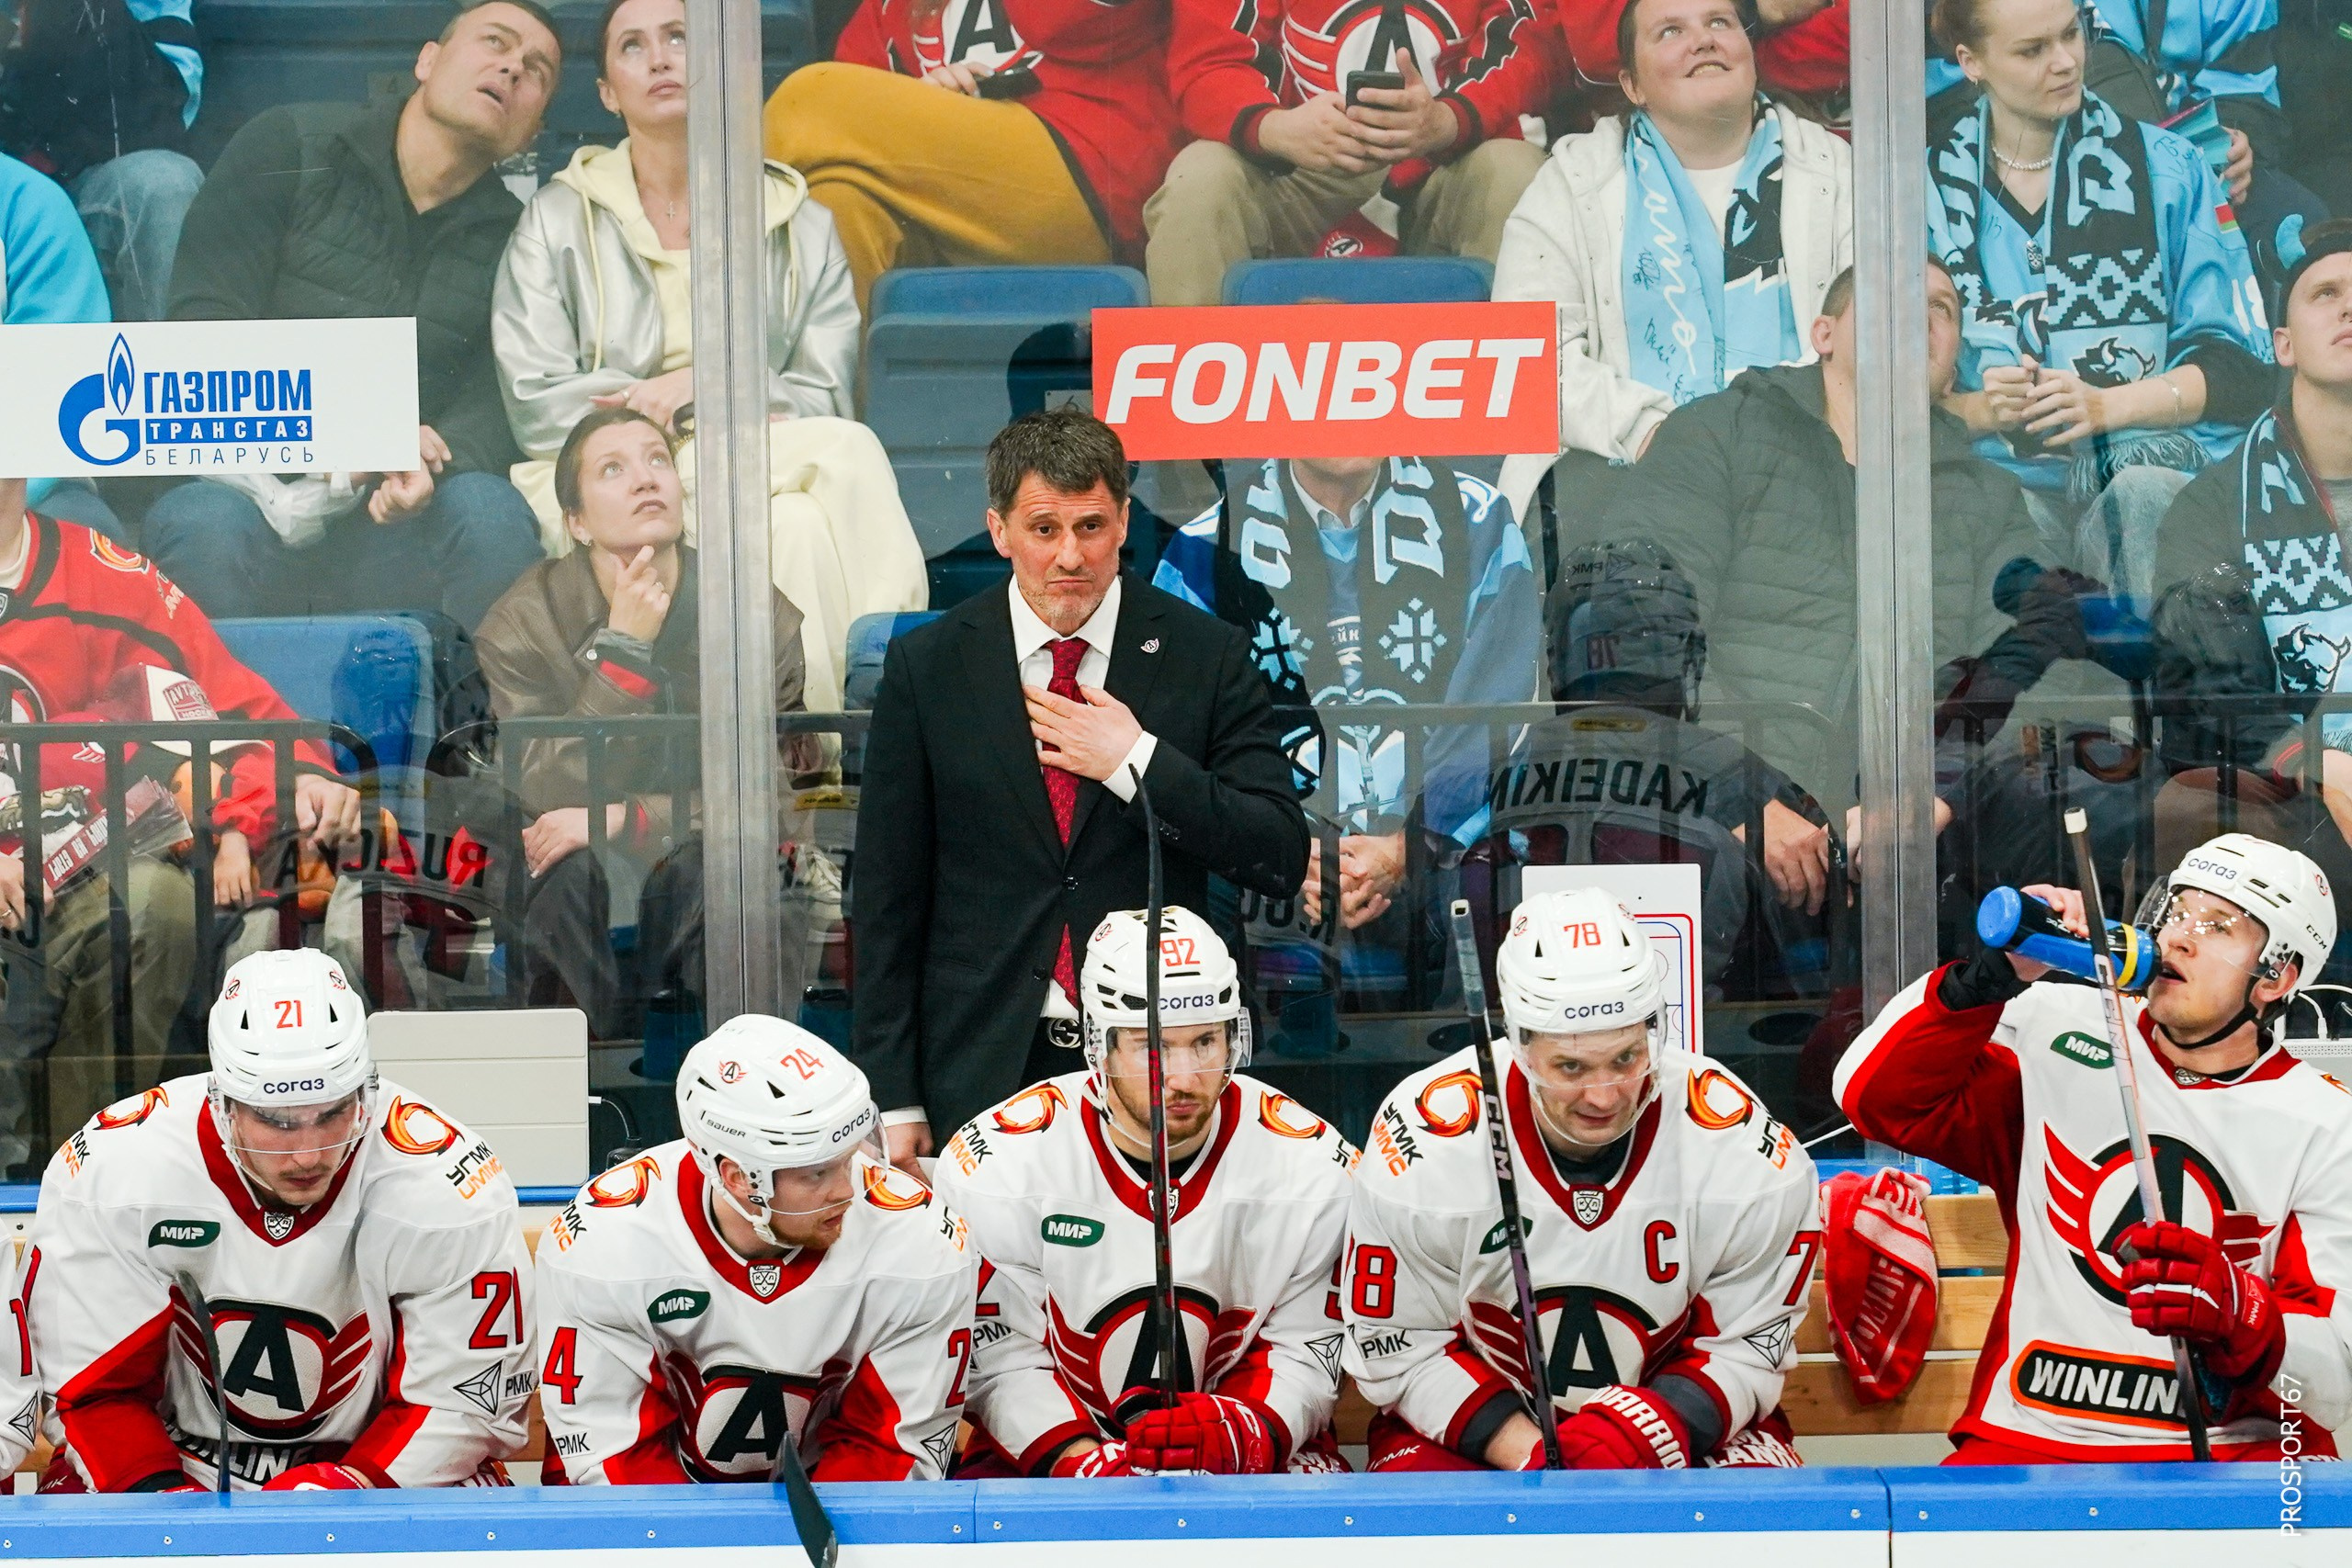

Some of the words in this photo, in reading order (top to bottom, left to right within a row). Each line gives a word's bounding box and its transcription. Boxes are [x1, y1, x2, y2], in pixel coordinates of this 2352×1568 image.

[143, 369, 311, 413] ГАЗПРОМ
[1104, 338, 1546, 424] FONBET
[150, 420, 309, 440] ТРАНСГАЗ
[145, 446, 313, 466] БЕЛАРУСЬ
[2188, 857, 2237, 880] согаз
[1563, 922, 1601, 948] 78
[2305, 924, 2327, 950] CCM
[1159, 938, 1201, 967] 92
[274, 999, 302, 1029] 21
[1159, 993, 1215, 1010] согаз
[1565, 1000, 1624, 1020] согаз
[2064, 1035, 2110, 1062] МИР
[780, 1047, 824, 1080] 24
[264, 1077, 325, 1094] согаз
[707, 1119, 746, 1139] BAUER
[831, 1108, 871, 1144] согаз
[1383, 1101, 1424, 1167] УГМК
[1485, 1094, 1512, 1181] CCM
[445, 1140, 493, 1188] УГМК
[159, 1224, 205, 1240] МИР
[1046, 1220, 1092, 1240] МИР
[1644, 1219, 1679, 1284] C
[1344, 1231, 1398, 1319] 8
[658, 1296, 695, 1315] МИР
[1360, 1328, 1413, 1359] РМК
[542, 1325, 584, 1405] 4
[505, 1371, 533, 1397] РМК
[556, 1431, 591, 1456] РМК
